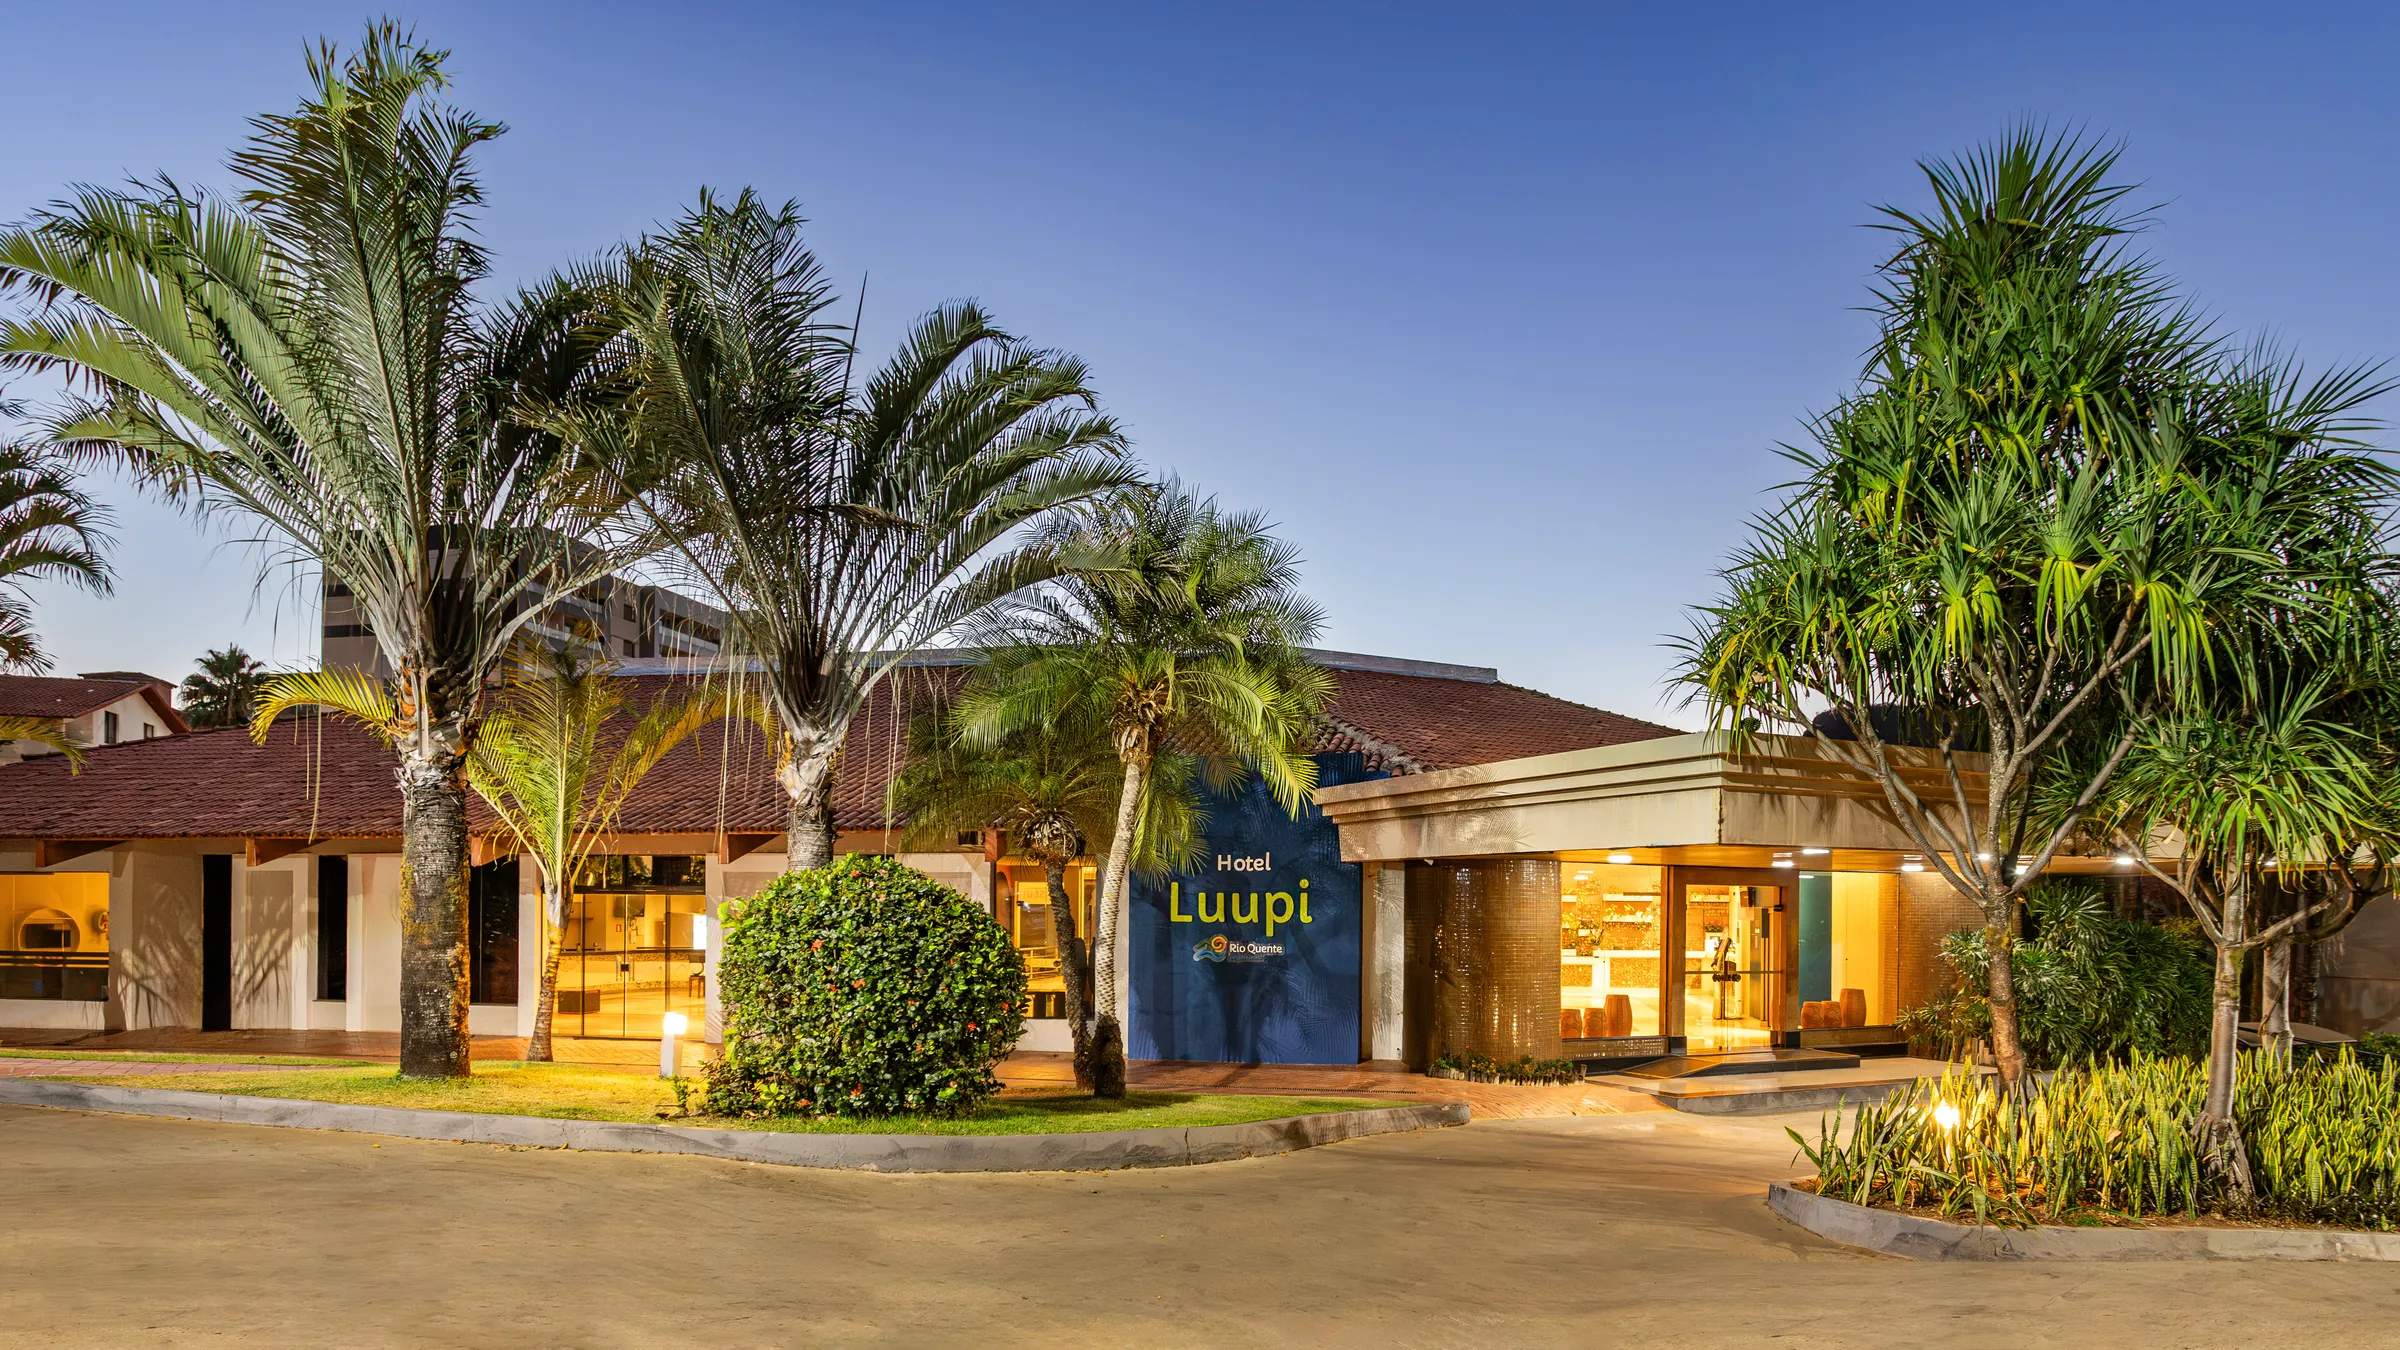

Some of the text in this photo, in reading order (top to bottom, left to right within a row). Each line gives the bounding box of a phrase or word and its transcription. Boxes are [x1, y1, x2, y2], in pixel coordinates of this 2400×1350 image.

[1217, 852, 1271, 872] Hotel
[1170, 879, 1313, 937] Luupi
[1229, 943, 1283, 954] Rio Quente
